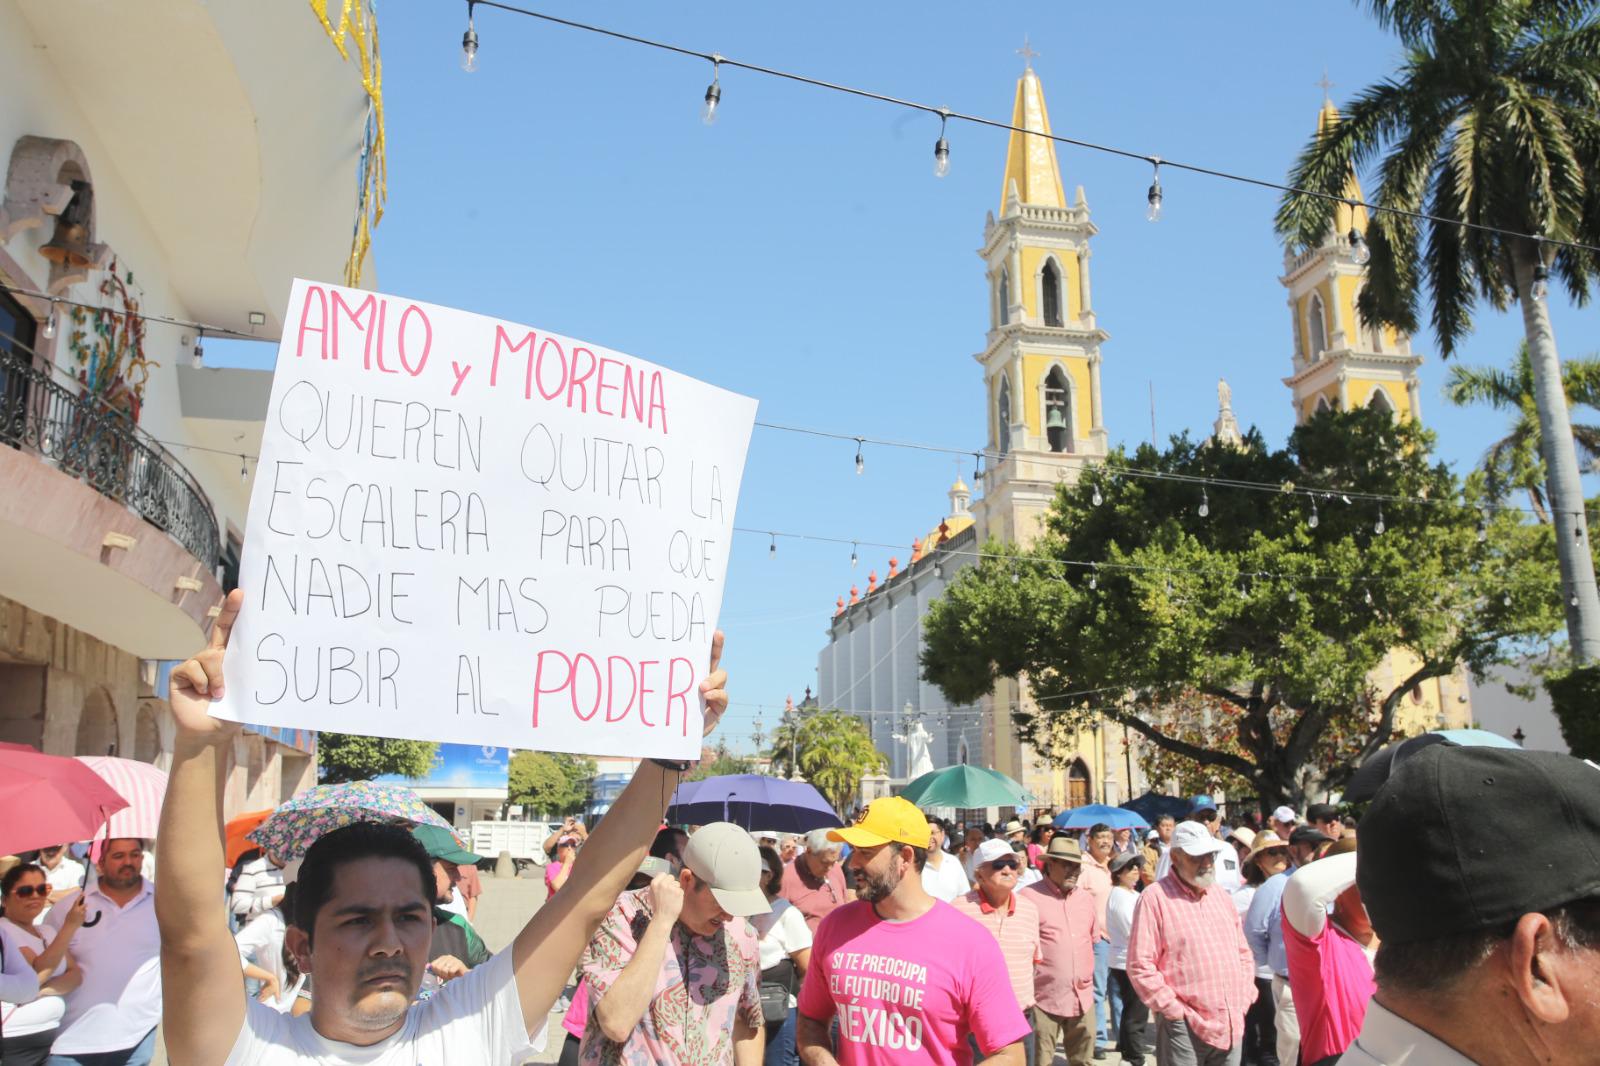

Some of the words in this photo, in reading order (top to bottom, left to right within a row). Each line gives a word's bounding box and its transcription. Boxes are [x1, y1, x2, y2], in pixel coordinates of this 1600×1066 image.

[296, 285, 432, 376] AMLO
[451, 361, 472, 396] y
[490, 325, 667, 434] MORENA
[279, 380, 482, 472] QUIEREN
[521, 423, 667, 509] QUITAR
[691, 460, 723, 524] LA
[268, 461, 489, 554] ESCALERA
[541, 510, 630, 571] PARA
[669, 530, 715, 581] QUE
[262, 554, 415, 624] NADIE
[457, 576, 548, 634] MAS
[594, 585, 706, 642] PUEDA
[255, 633, 400, 710] SUBIR
[457, 655, 499, 716] AL
[532, 650, 694, 737] PODER
[831, 974, 841, 994] EL
[845, 975, 900, 1004] FUTURO
[904, 987, 925, 1011] DE
[832, 952, 843, 970] SI
[845, 953, 860, 970] TE
[861, 954, 927, 984] PREOCUPA
